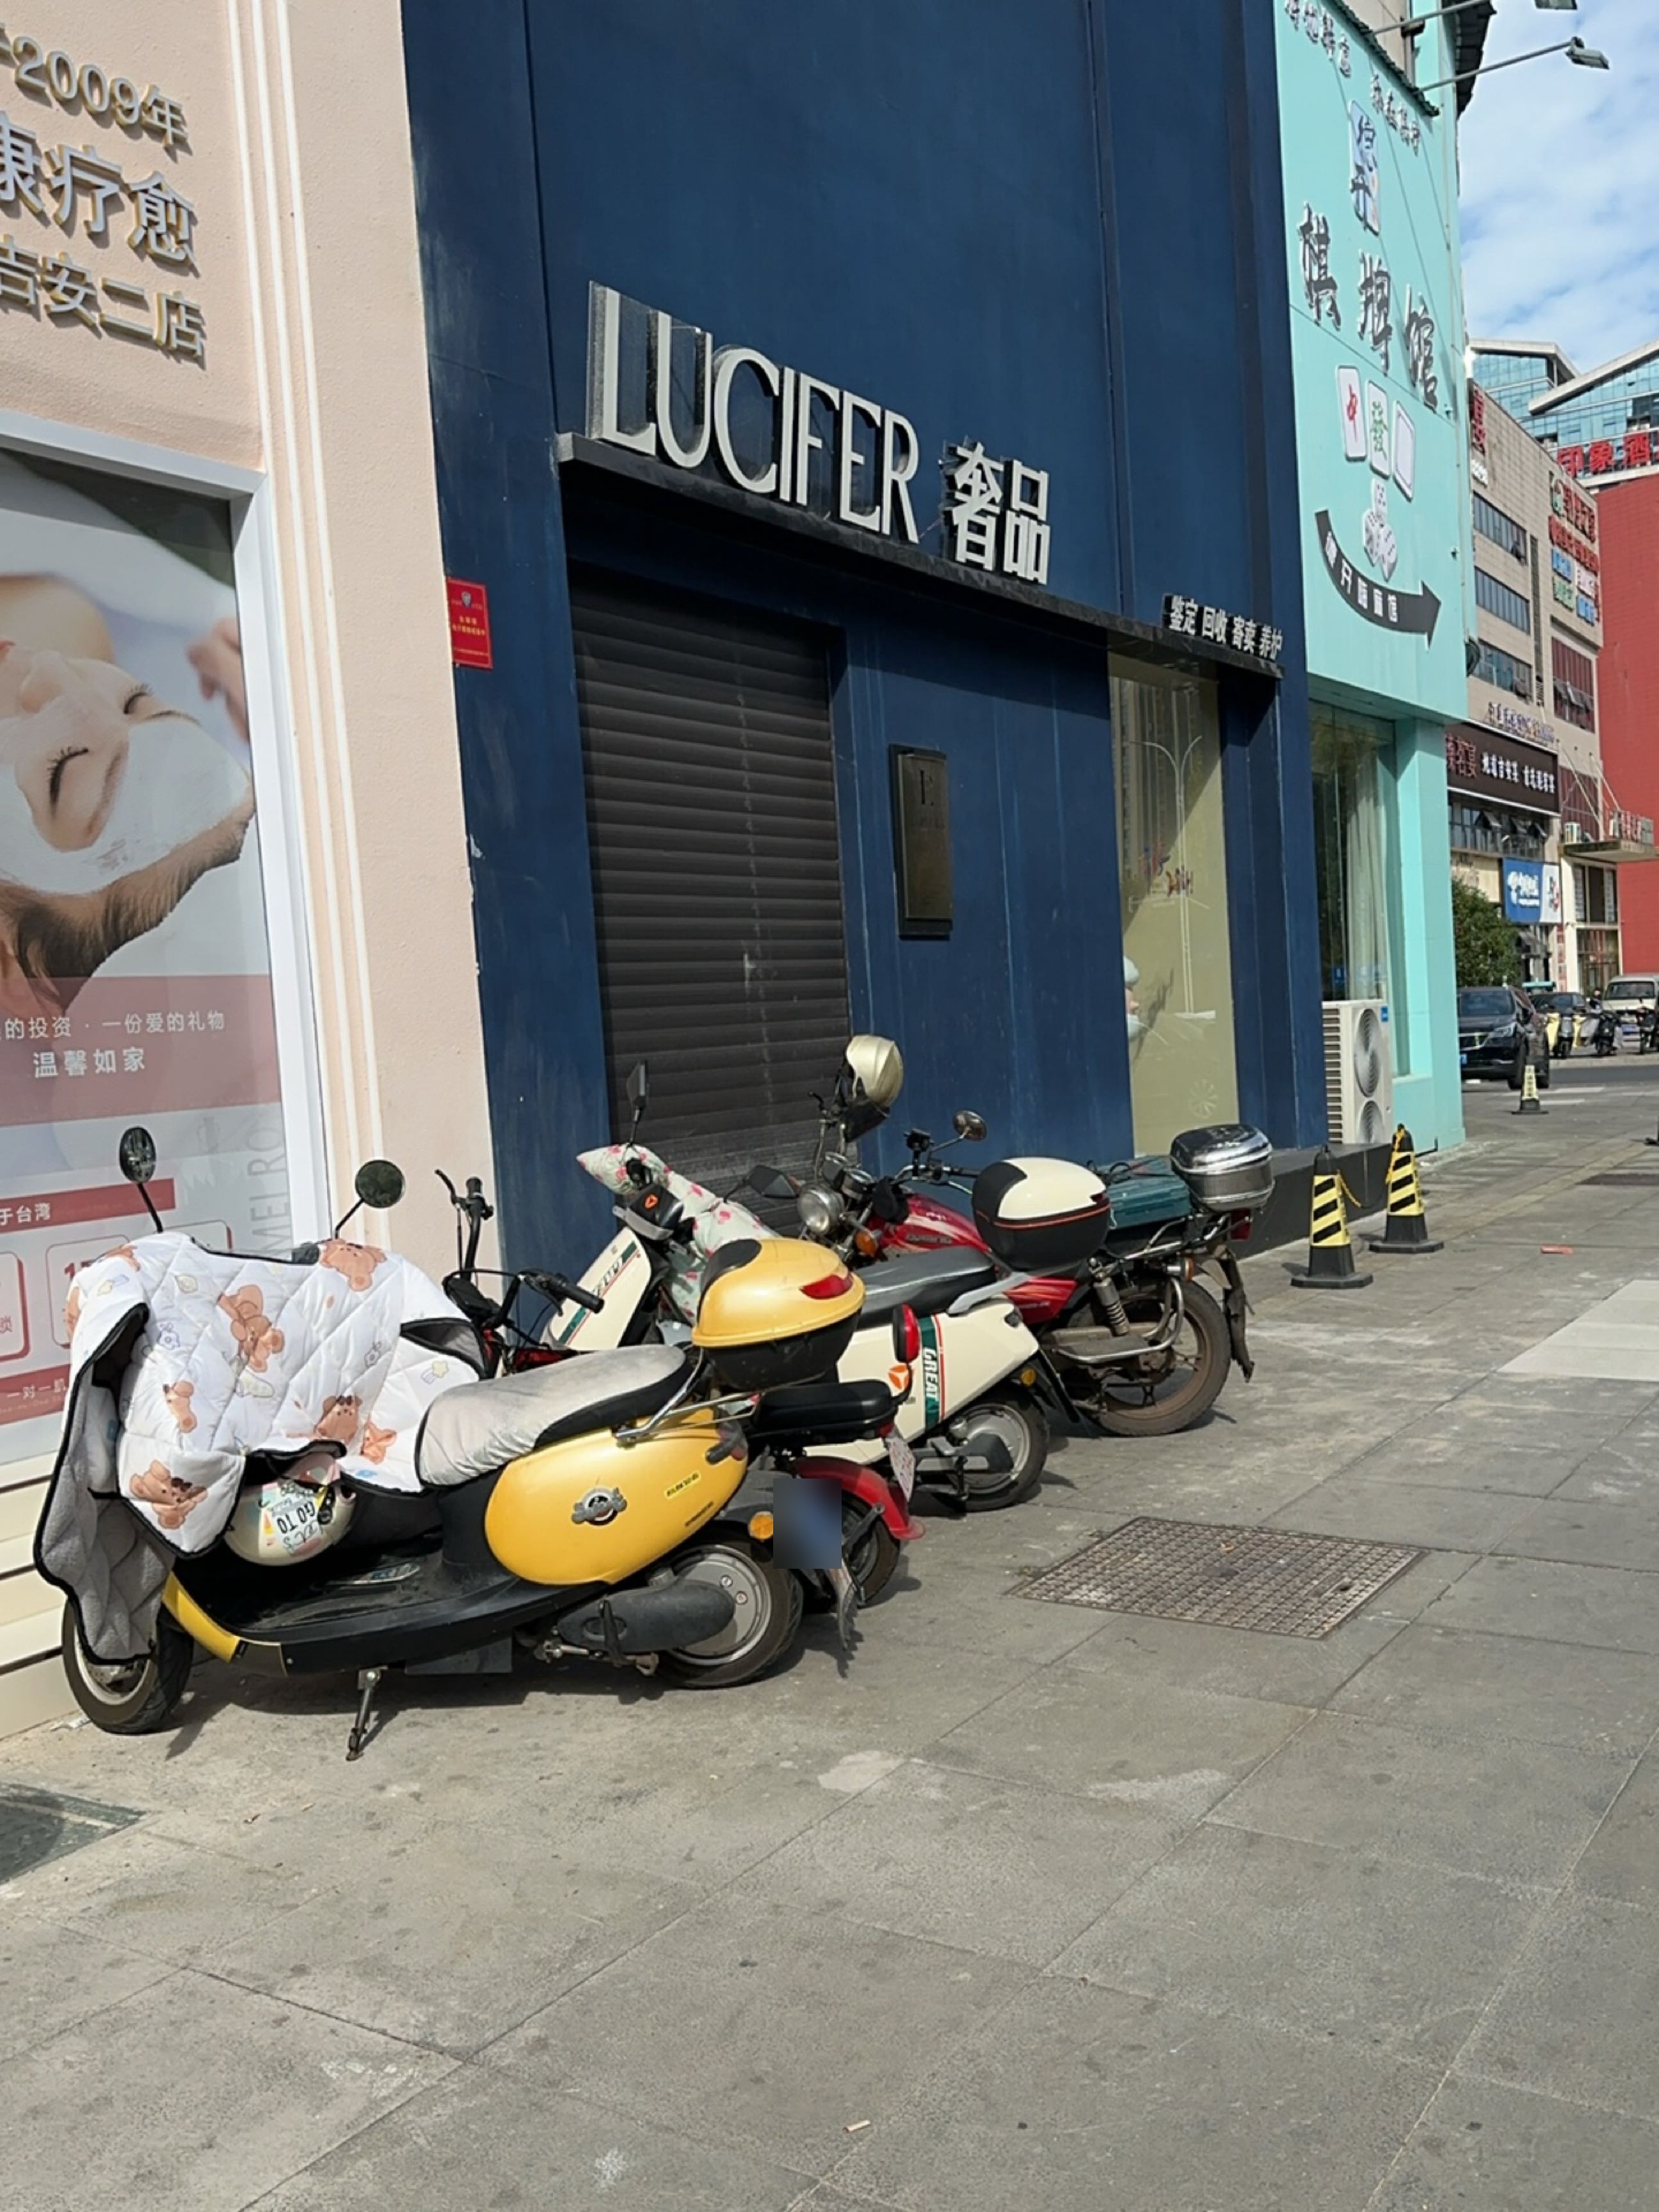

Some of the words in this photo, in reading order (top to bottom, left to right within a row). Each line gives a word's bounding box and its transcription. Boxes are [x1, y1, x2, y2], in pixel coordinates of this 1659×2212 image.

[588, 282, 919, 544] LUCIFER
[947, 438, 1050, 585] 奢品
[33, 1046, 146, 1078] 温馨如家
[923, 1347, 940, 1401] GREAT
